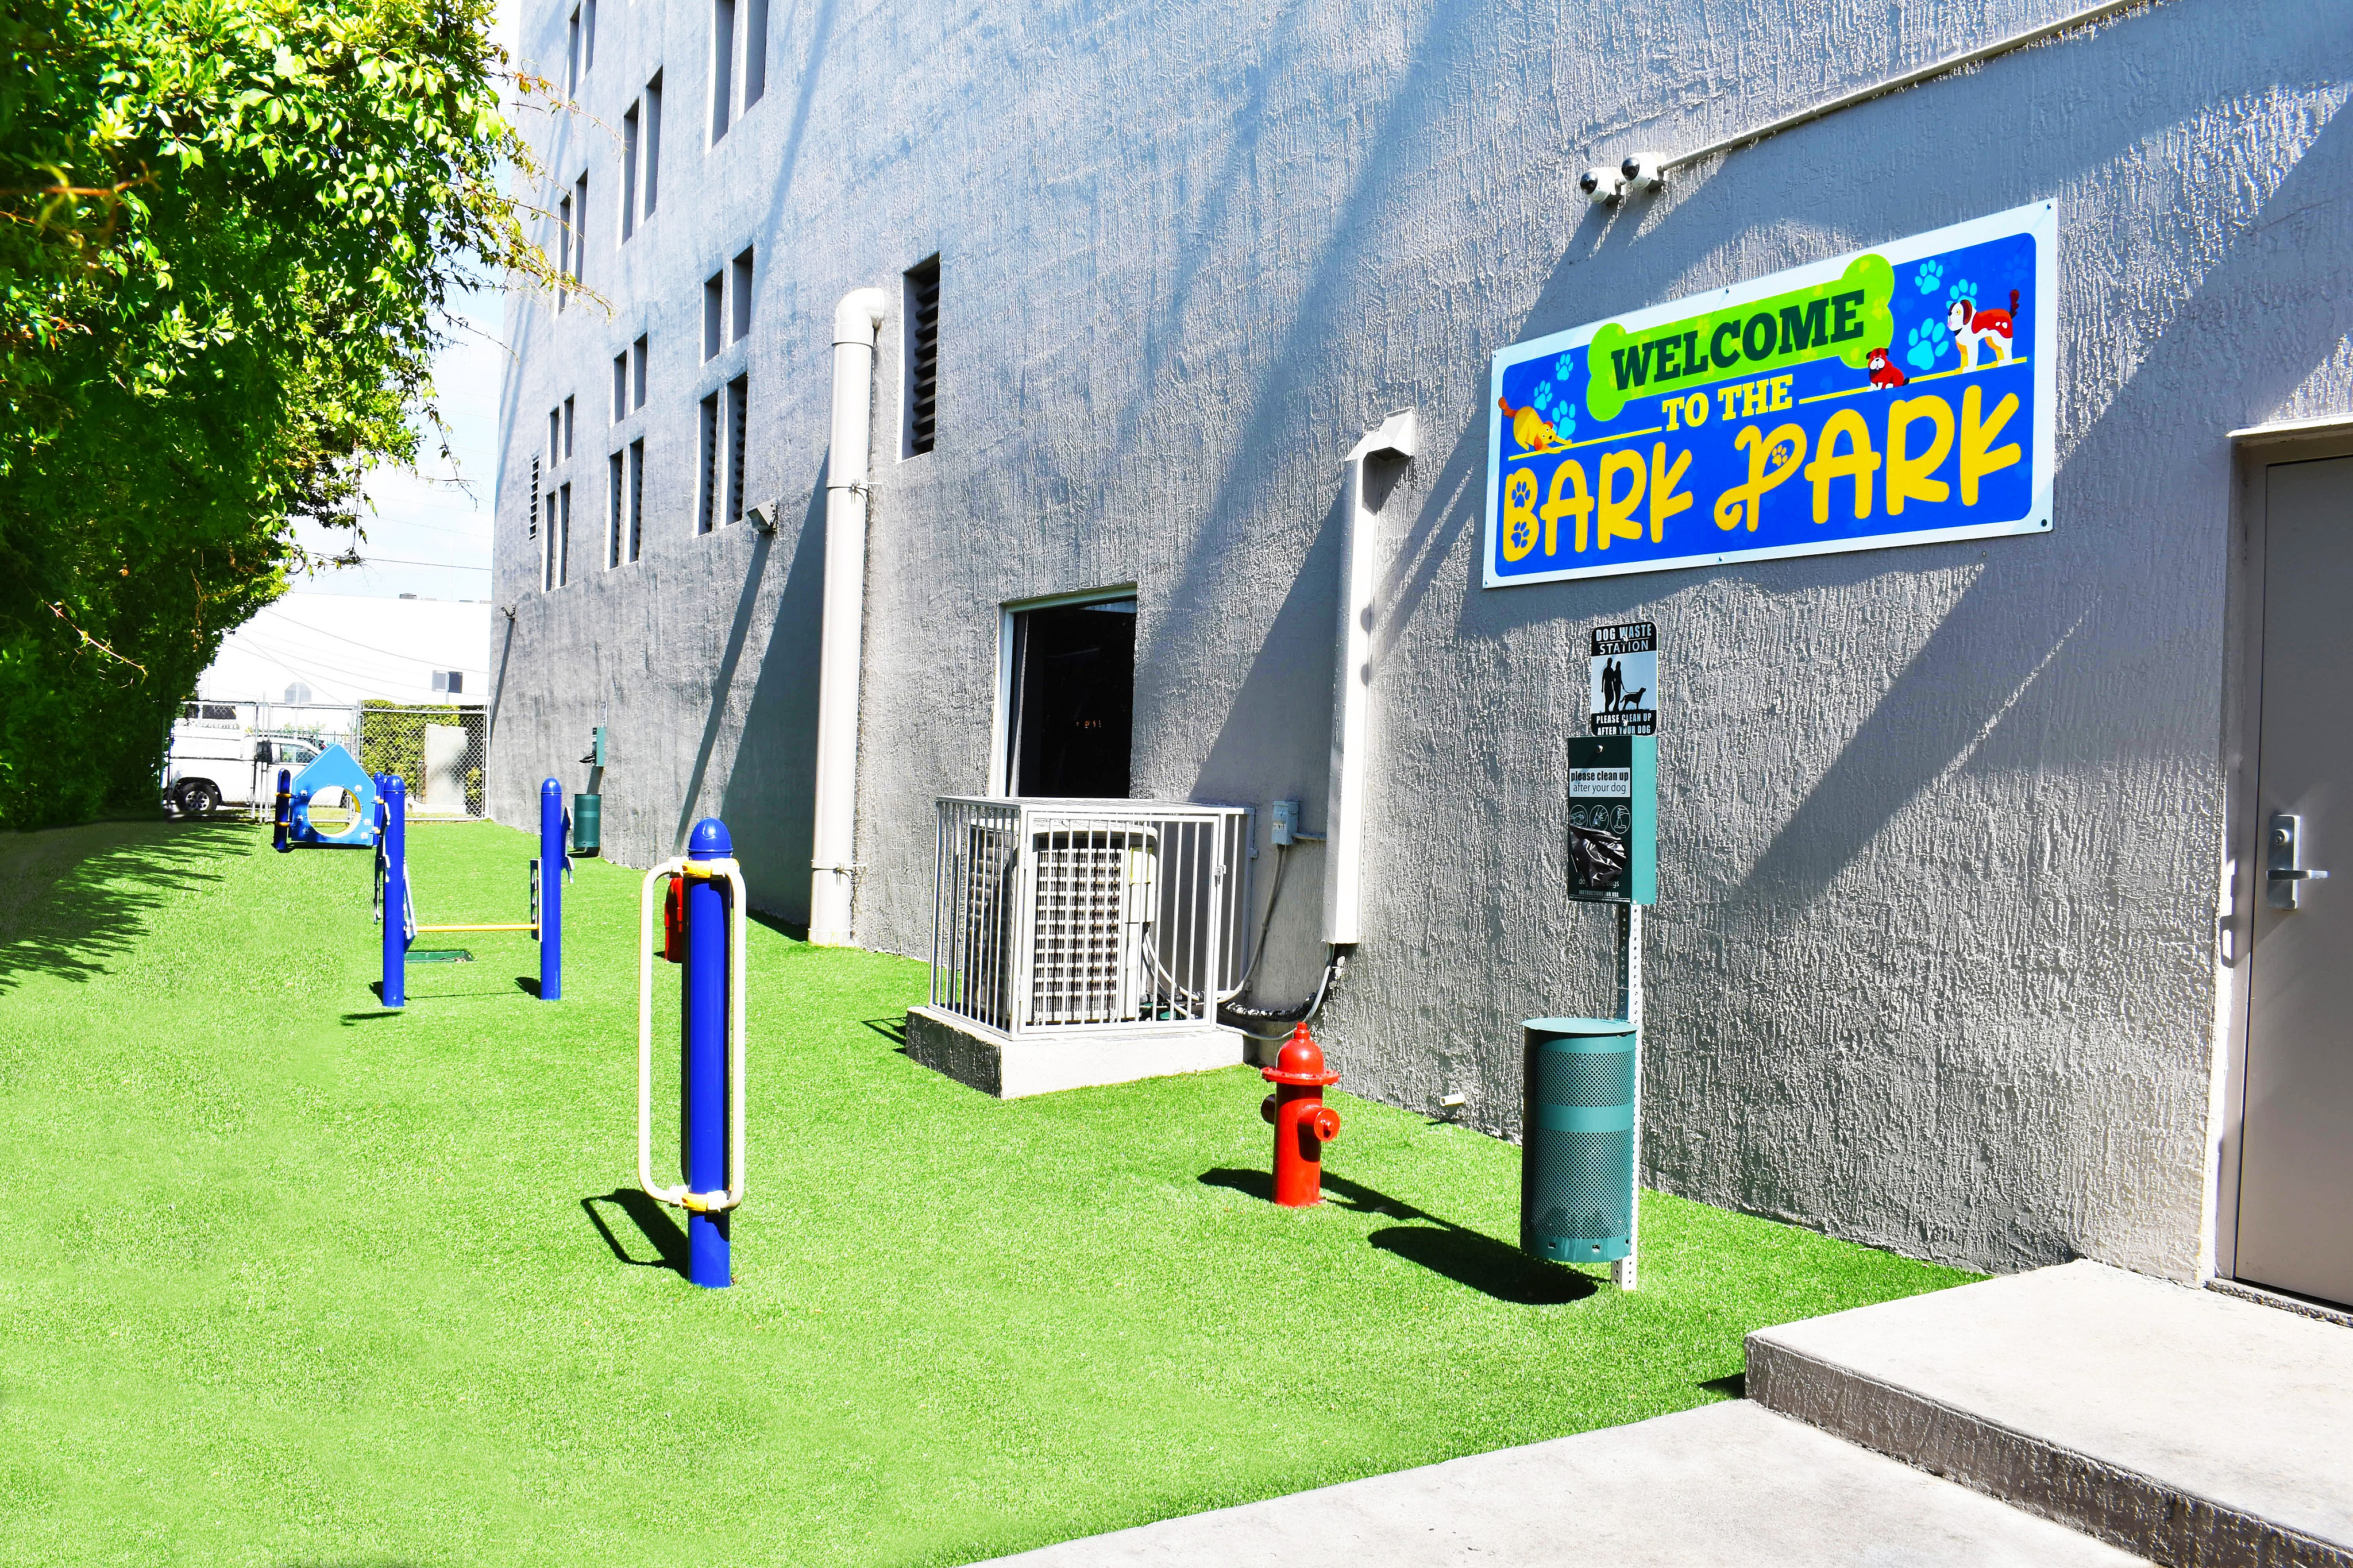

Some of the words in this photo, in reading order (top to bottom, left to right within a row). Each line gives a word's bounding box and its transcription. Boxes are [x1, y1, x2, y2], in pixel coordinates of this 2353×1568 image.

[1611, 289, 1865, 391] WELCOME
[1662, 393, 1709, 431] TO
[1718, 374, 1793, 420] THE
[1503, 442, 1693, 562] BARK
[1714, 385, 2022, 532] PARK
[1596, 628, 1615, 641] DOG
[1619, 624, 1652, 639] WASTE
[1600, 640, 1648, 654] STATION
[1596, 715, 1619, 724] PLEASE
[1622, 713, 1641, 722] CLEAN
[1644, 713, 1652, 721] UP
[1598, 727, 1617, 735] AFTER
[1619, 726, 1635, 735] YOUR
[1638, 725, 1650, 734] DOG
[1571, 771, 1595, 782] please
[1597, 771, 1618, 781] clean
[1619, 772, 1629, 782] up
[1573, 782, 1591, 792] after
[1592, 785, 1609, 794] your
[1611, 782, 1626, 794] dog
